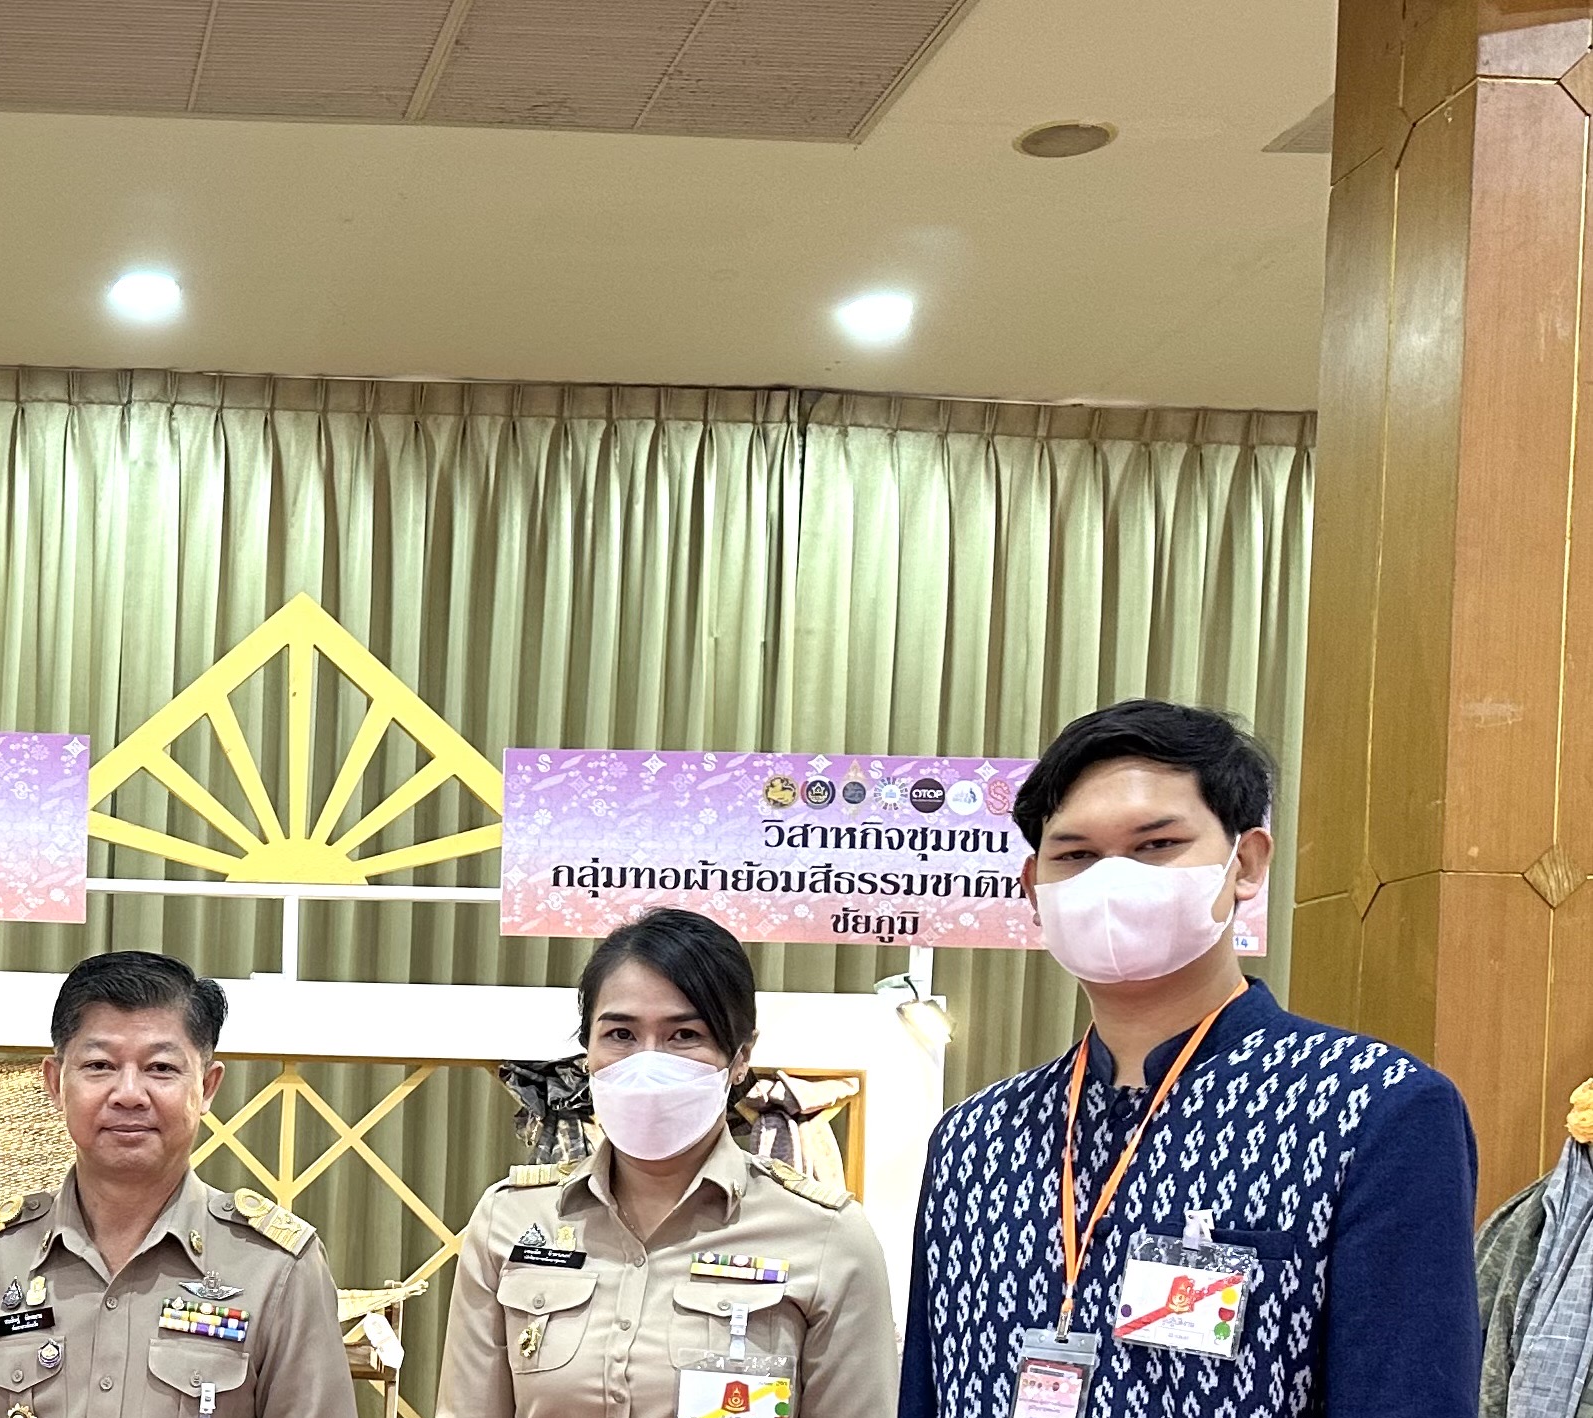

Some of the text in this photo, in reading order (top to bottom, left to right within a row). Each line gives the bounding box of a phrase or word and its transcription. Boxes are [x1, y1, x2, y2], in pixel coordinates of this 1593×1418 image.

[912, 790, 943, 800] OTOP
[761, 819, 1010, 862] วิสาหกิจชุมชน
[551, 856, 1026, 899] กลุ่มทอผ้าย้อมสีธรรมชาติห
[831, 907, 920, 944] ชัยภูมิ
[1235, 937, 1248, 948] 14
